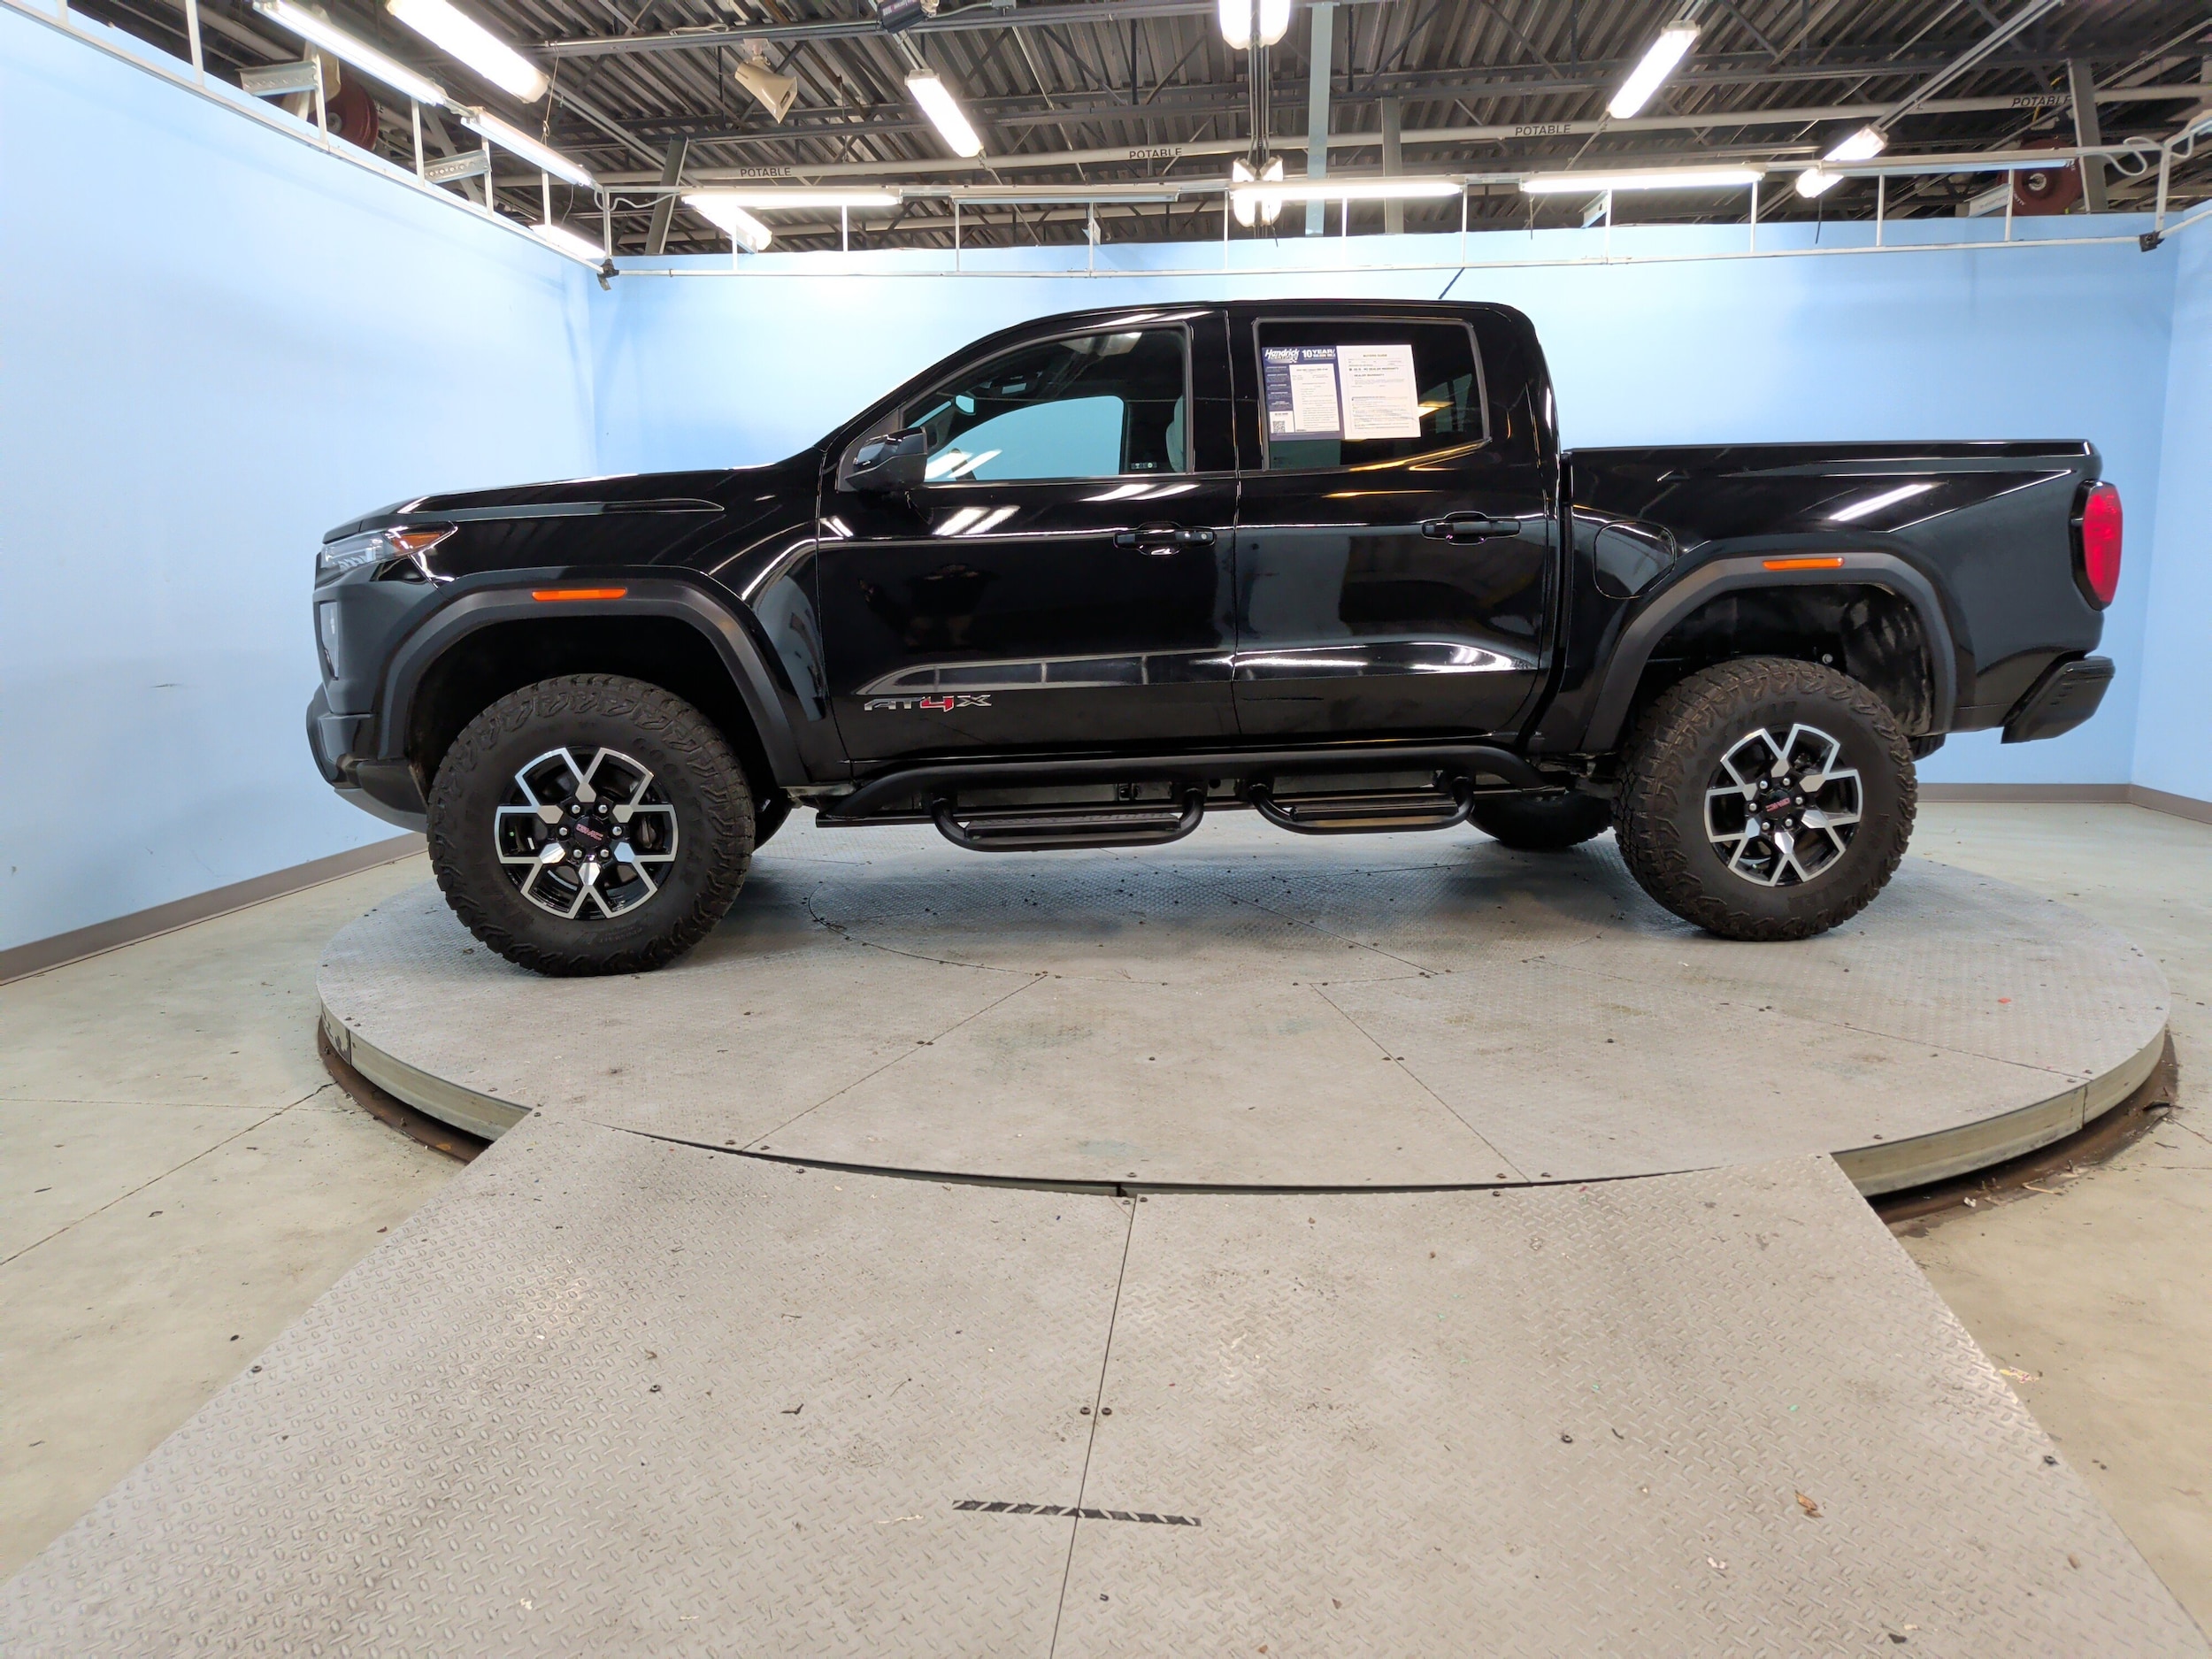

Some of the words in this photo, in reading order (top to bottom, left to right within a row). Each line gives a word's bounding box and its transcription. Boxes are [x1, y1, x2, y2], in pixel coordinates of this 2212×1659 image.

[1515, 124, 1571, 136] POTABLE
[1129, 147, 1182, 159] POTABLE
[740, 167, 792, 178] POTABLE
[1302, 349, 1313, 358] 10
[864, 694, 992, 713] AT4X
[1765, 797, 1791, 812] GMC
[575, 823, 603, 841] GMC
